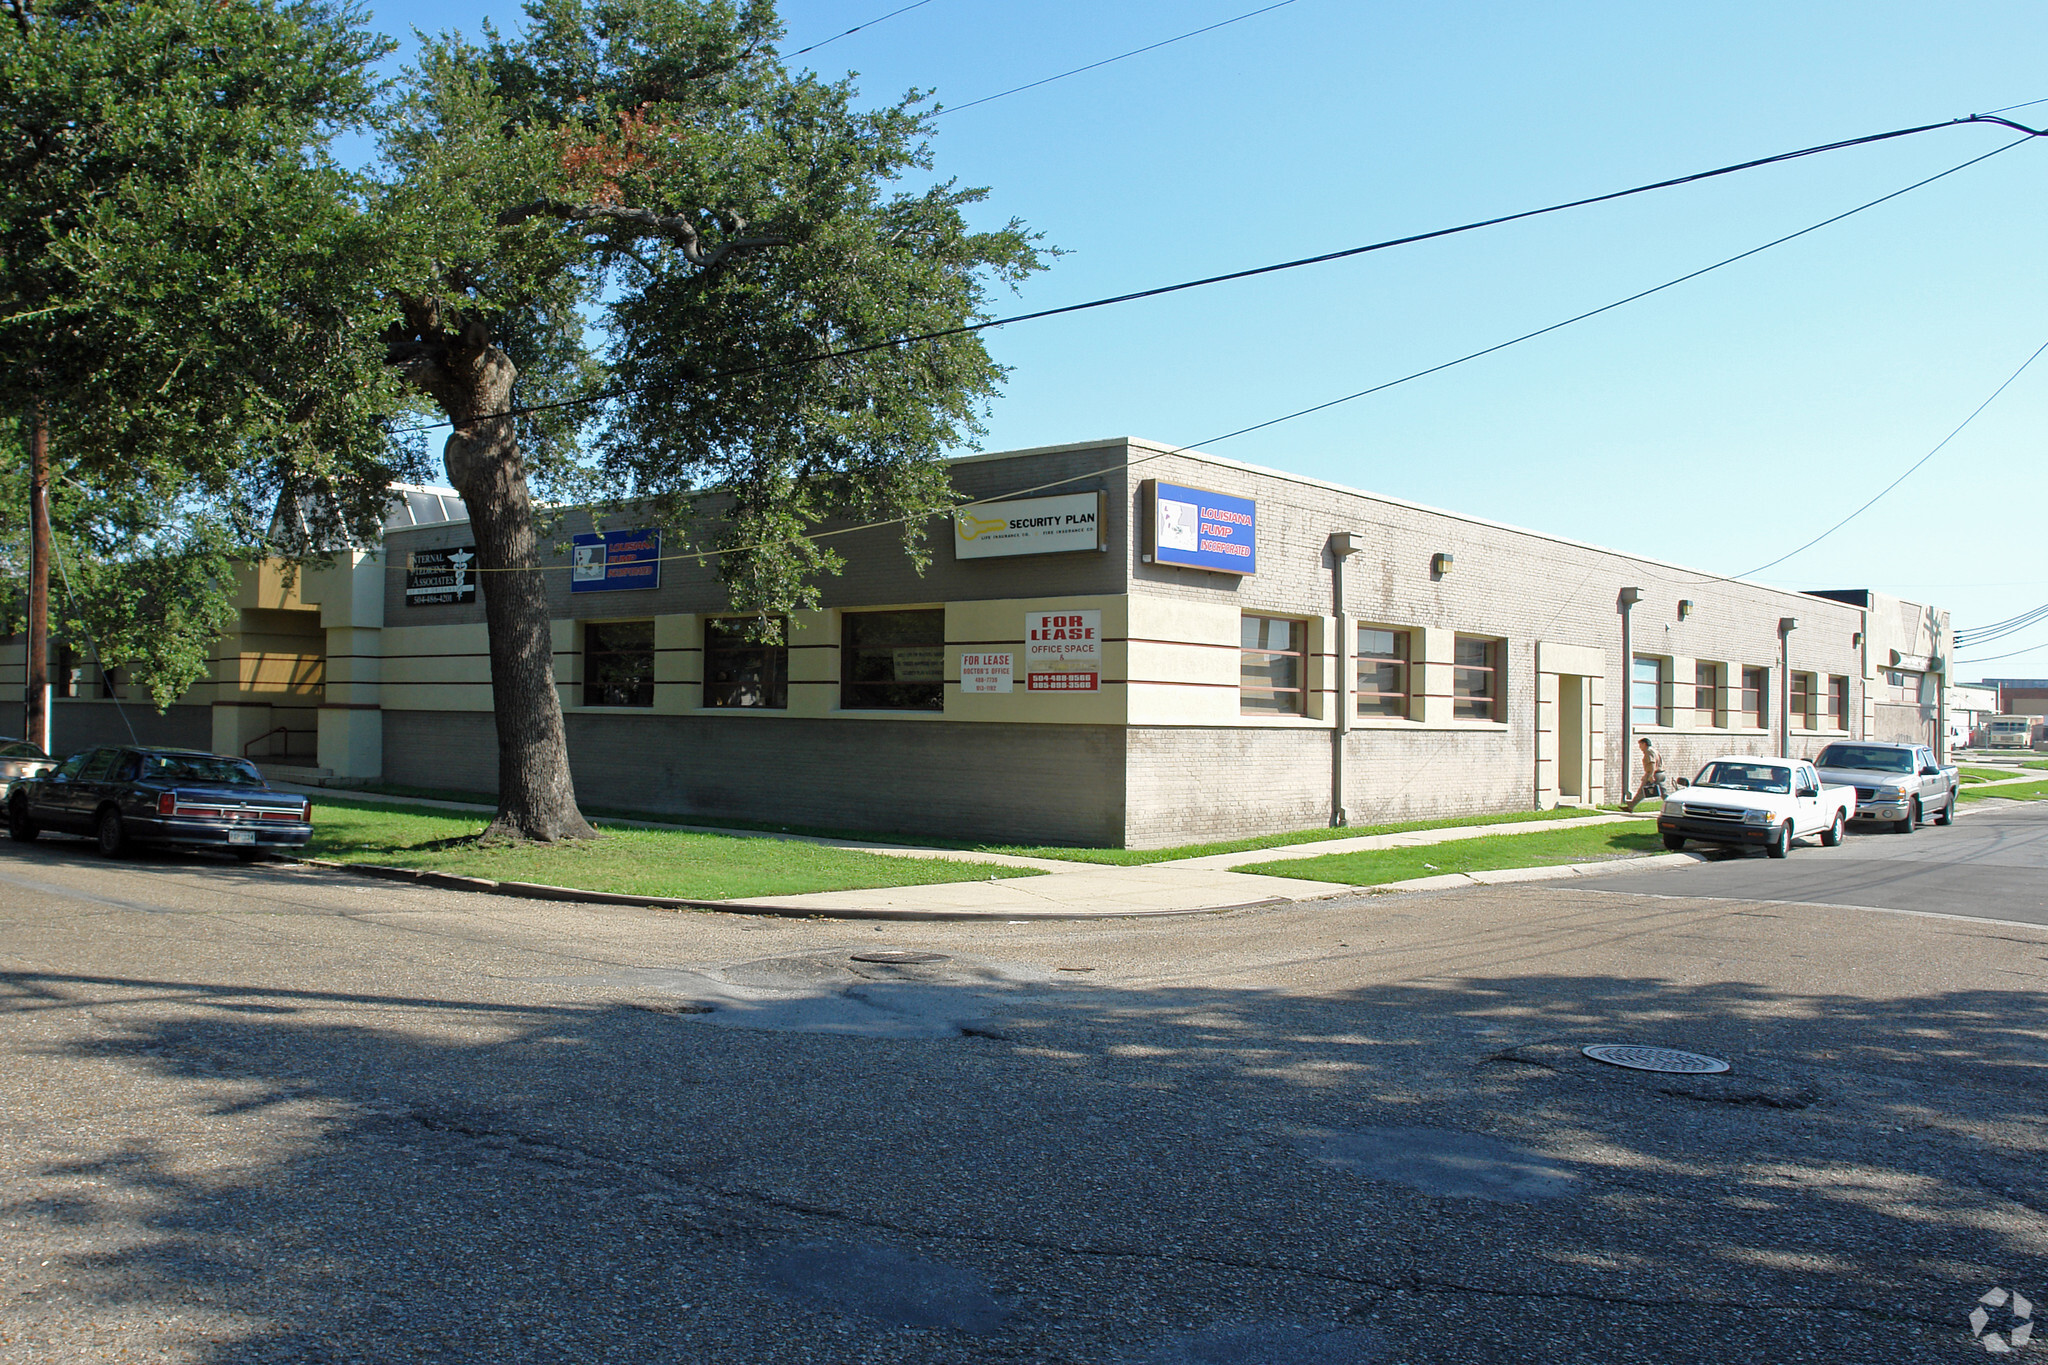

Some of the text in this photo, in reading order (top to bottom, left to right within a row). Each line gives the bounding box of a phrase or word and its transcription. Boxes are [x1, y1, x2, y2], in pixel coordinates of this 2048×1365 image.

[1009, 513, 1095, 529] SECURITY PLAN
[1200, 507, 1252, 526] LOUISIANA
[1200, 523, 1233, 537] PUMP
[1200, 539, 1251, 557] INCORPORATED
[412, 577, 454, 587] ASSOCIATES
[1041, 615, 1083, 628] FOR
[1031, 628, 1095, 641] LEASE
[1031, 644, 1094, 653] OFFICE SPACE
[963, 655, 1009, 665] FOR LEASE
